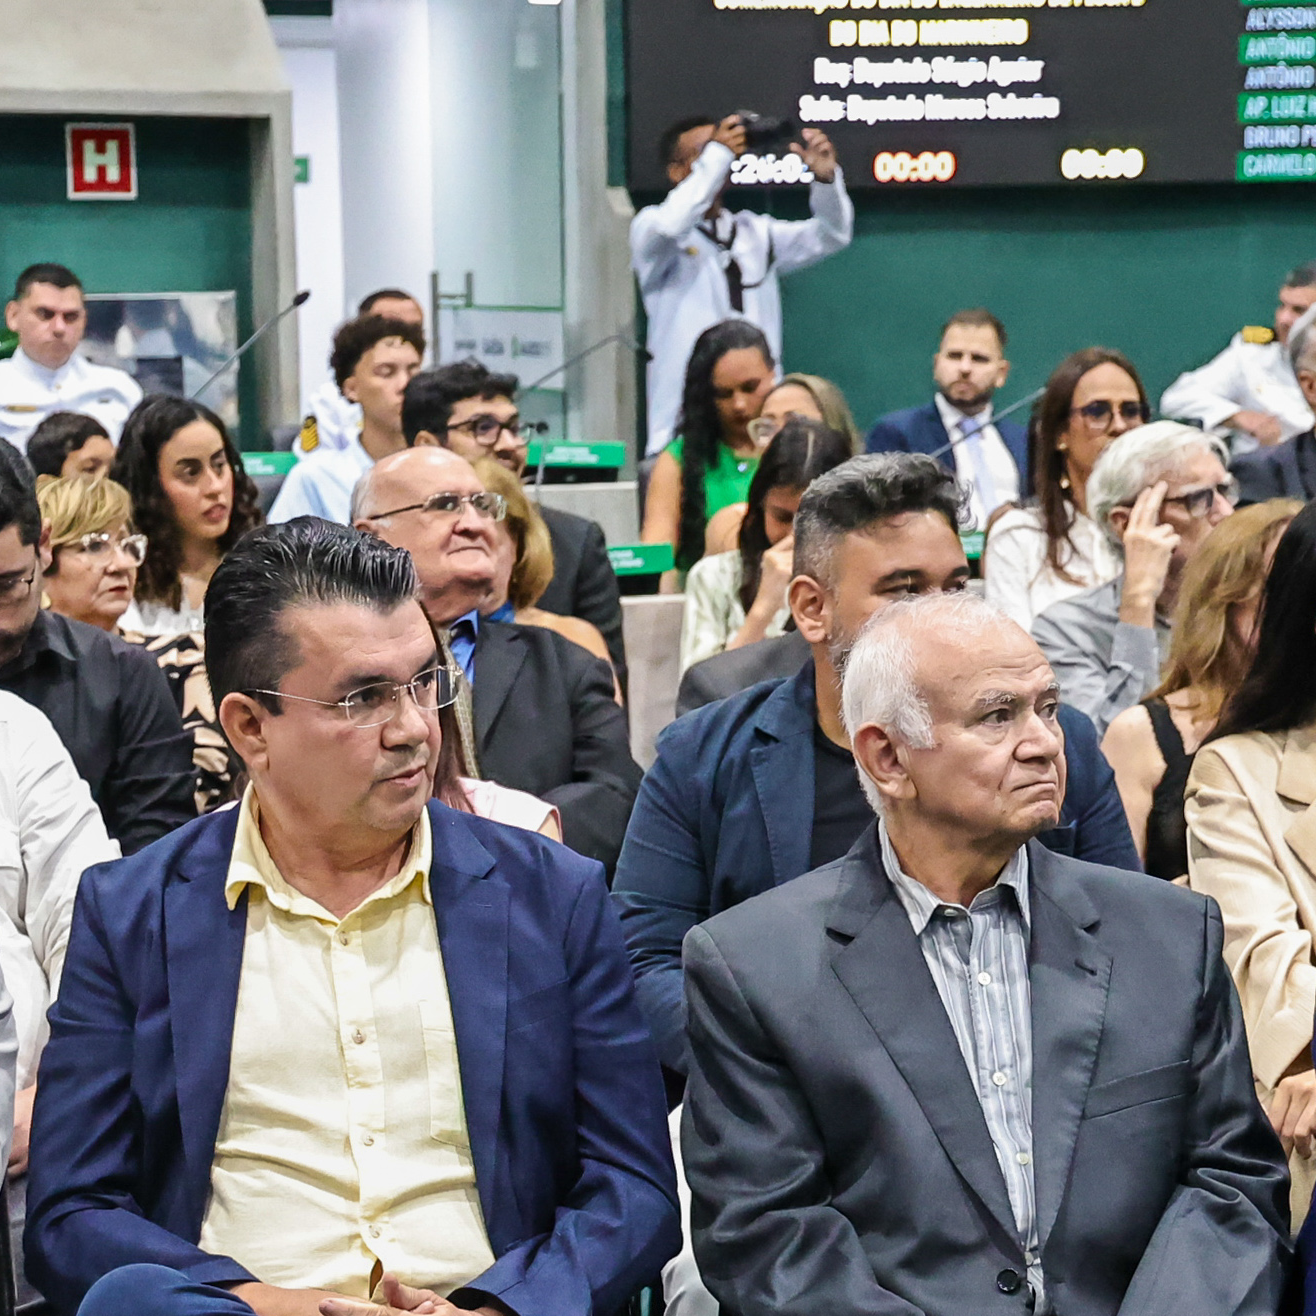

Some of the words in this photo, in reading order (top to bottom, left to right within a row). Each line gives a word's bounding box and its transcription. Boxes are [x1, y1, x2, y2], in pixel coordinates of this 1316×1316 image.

[1245, 32, 1316, 60] ANTÔNIO
[1244, 61, 1315, 89] ANTÔNIO
[1271, 94, 1307, 119] LUIZ
[1244, 125, 1300, 149] BRUNO
[83, 139, 120, 183] H
[874, 151, 956, 182] 00:00
